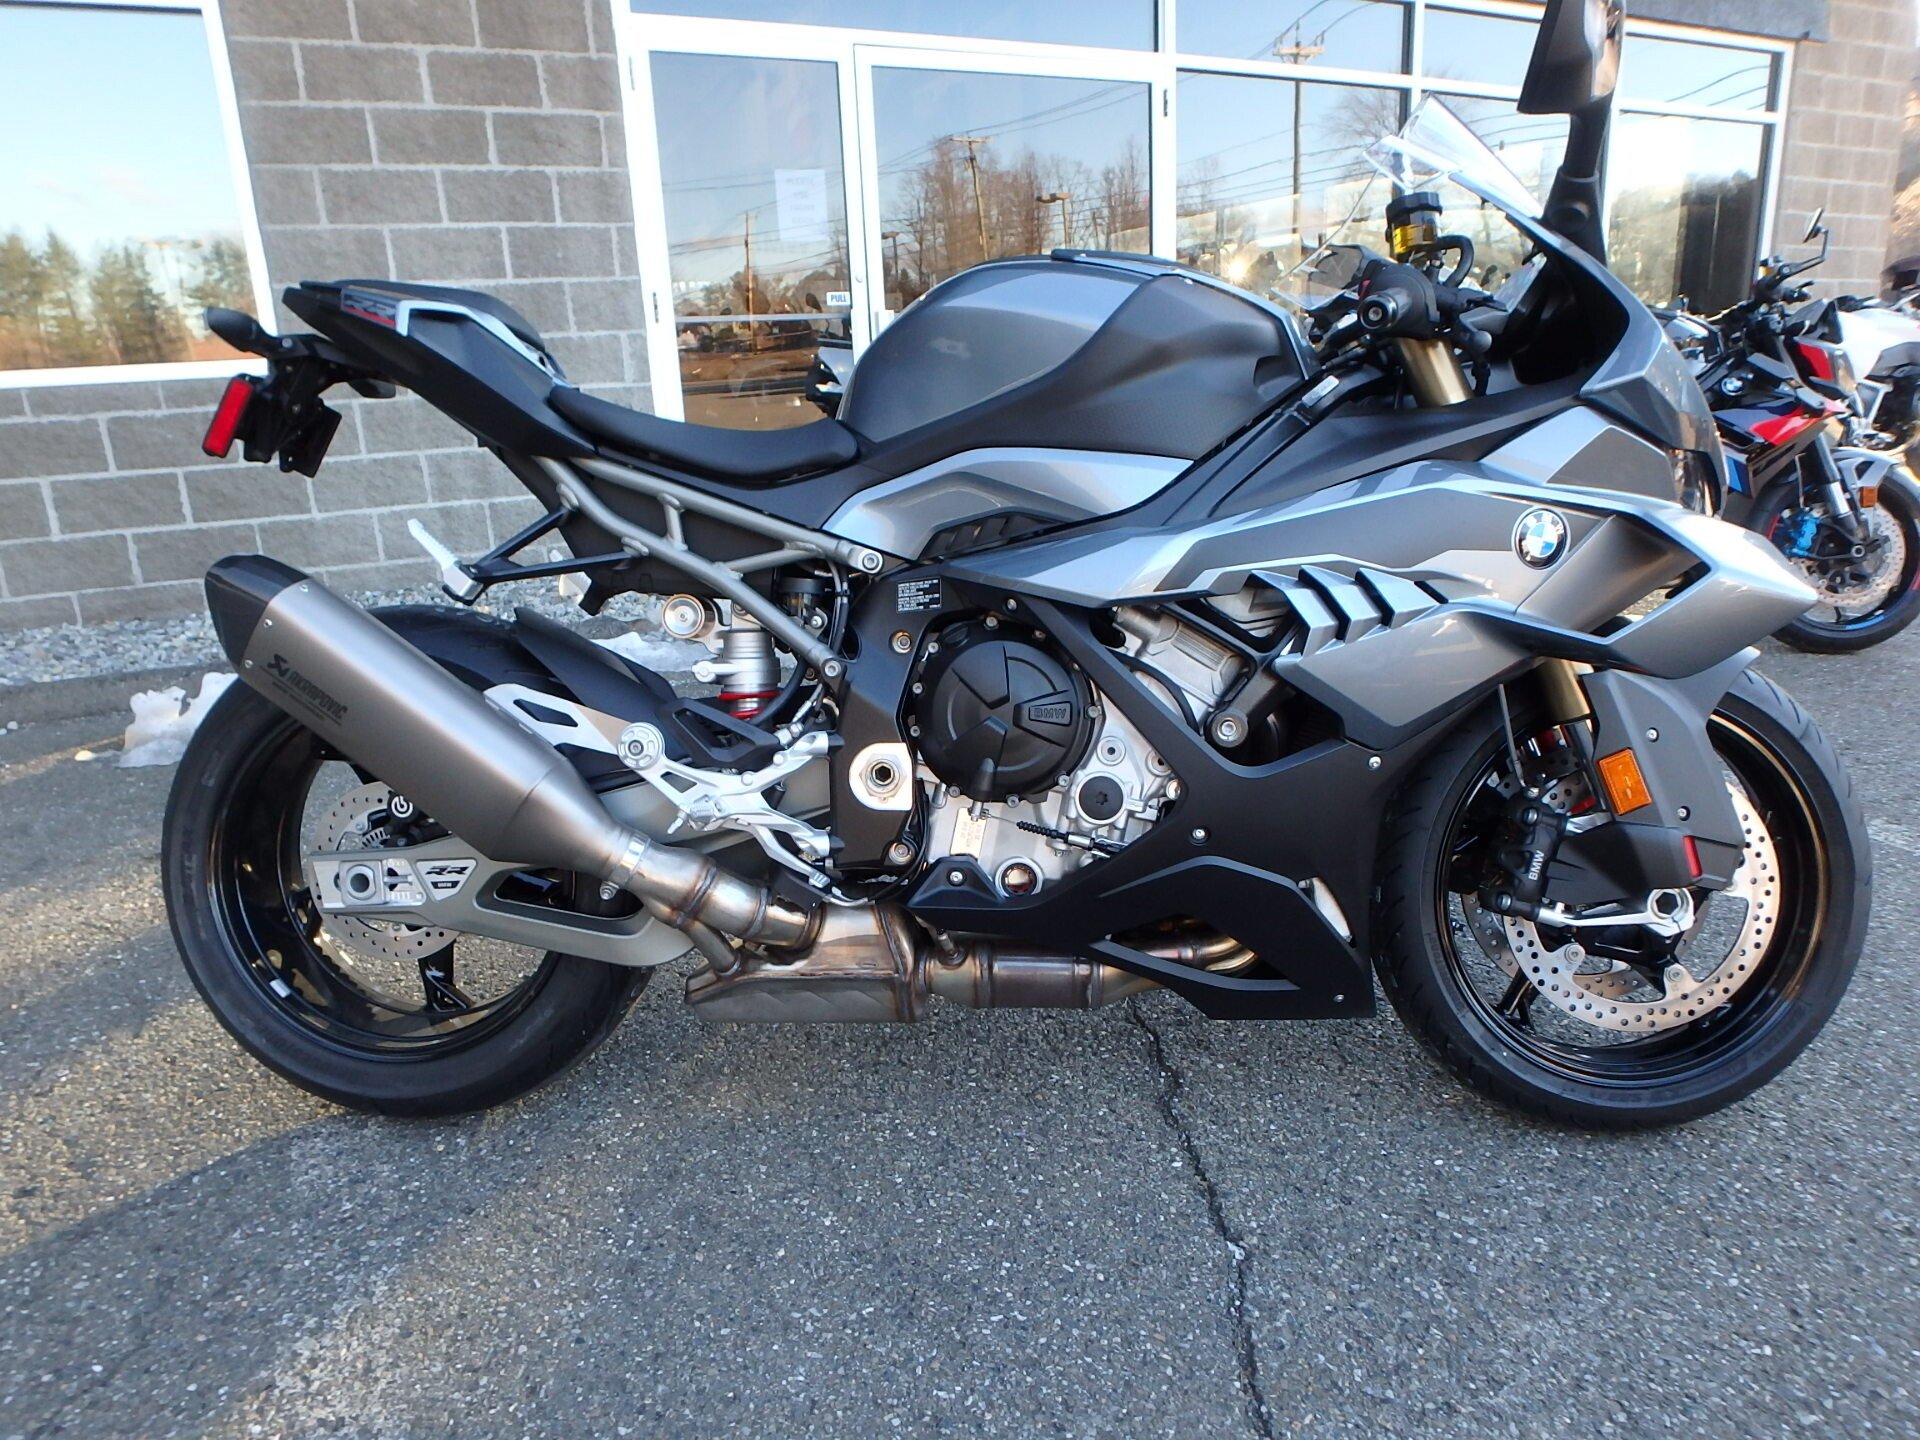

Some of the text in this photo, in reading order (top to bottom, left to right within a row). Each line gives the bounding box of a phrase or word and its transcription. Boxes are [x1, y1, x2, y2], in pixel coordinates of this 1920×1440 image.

[831, 294, 848, 303] PULL
[1033, 707, 1067, 719] BMW
[1528, 849, 1545, 881] BMW
